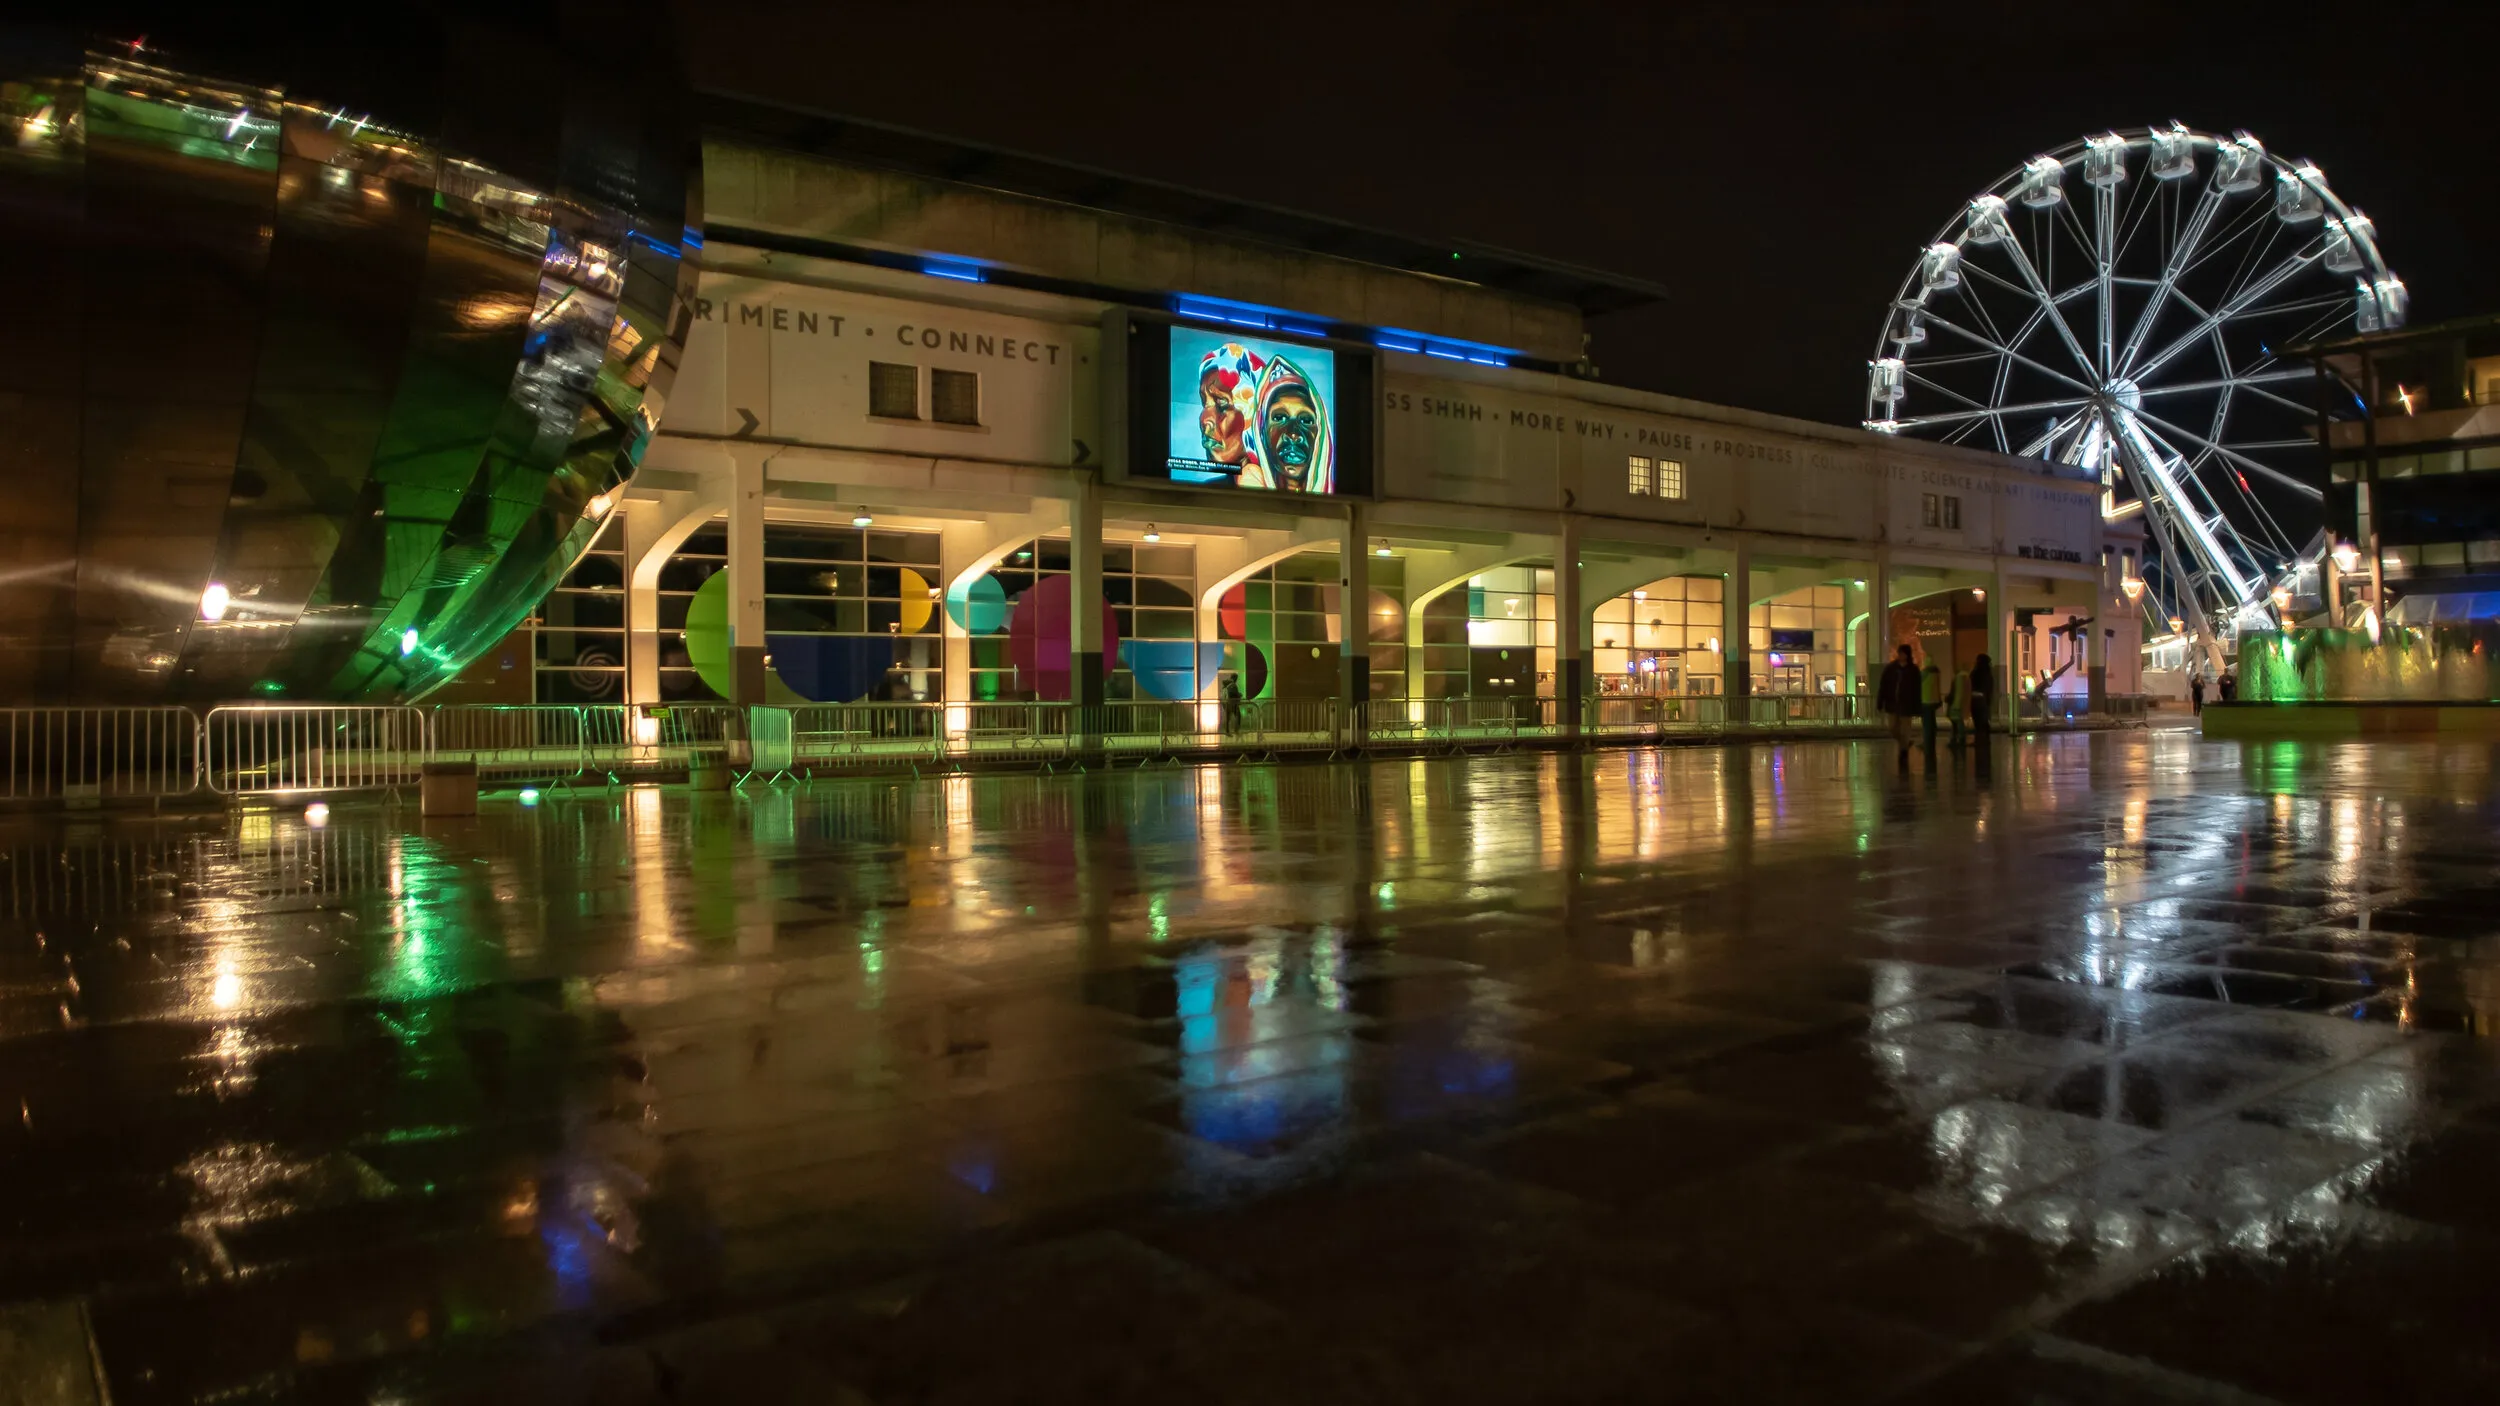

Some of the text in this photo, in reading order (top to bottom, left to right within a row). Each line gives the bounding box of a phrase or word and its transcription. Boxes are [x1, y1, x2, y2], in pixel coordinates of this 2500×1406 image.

[897, 324, 1060, 365] CONNECT
[1422, 397, 1482, 422] SHHH
[1510, 409, 1565, 432] MORE
[1575, 418, 1615, 440] WHY
[1638, 428, 1693, 451] PAUSE
[1713, 439, 1793, 464] PROGRESS
[1922, 470, 1972, 490] SCIENCE
[2018, 545, 2032, 559] we
[2033, 544, 2049, 561] the
